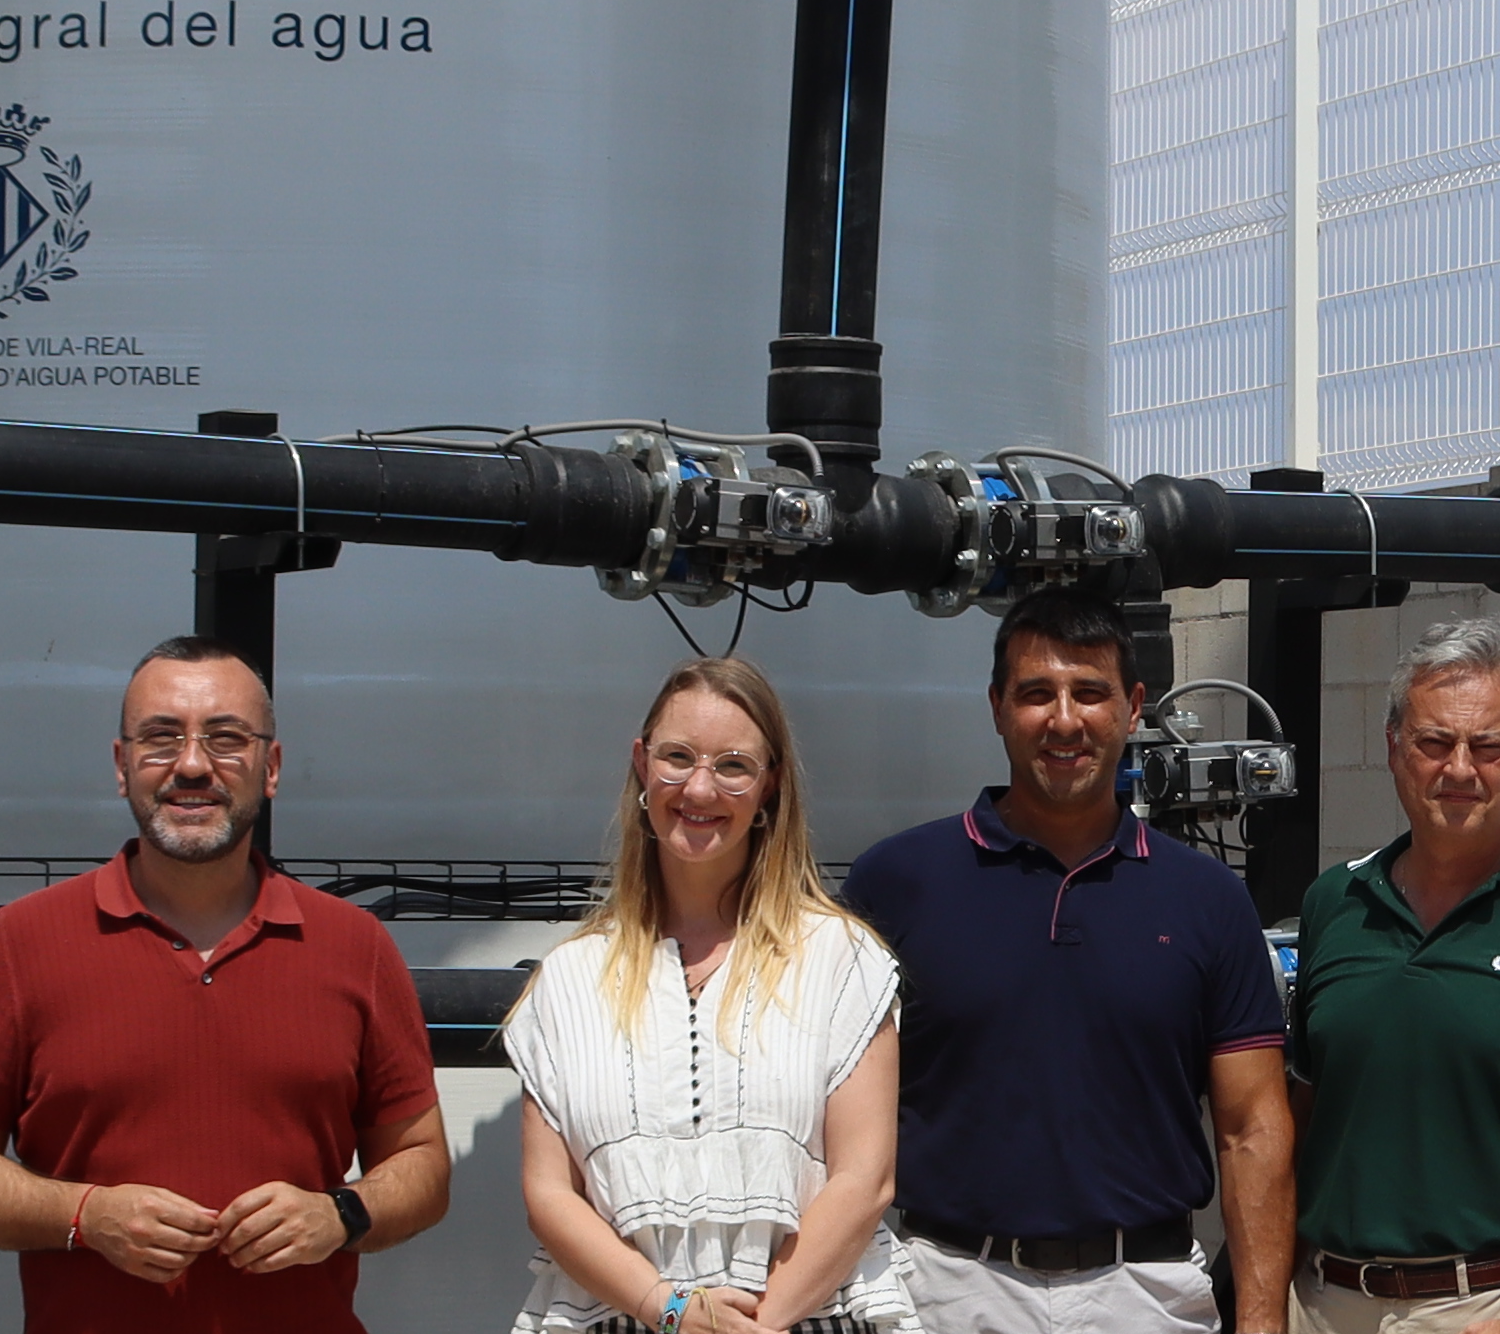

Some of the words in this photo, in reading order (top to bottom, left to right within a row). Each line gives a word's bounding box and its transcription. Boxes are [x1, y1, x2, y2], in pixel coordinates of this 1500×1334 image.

[141, 0, 236, 48] del
[271, 12, 433, 62] agua
[25, 336, 145, 357] VILA-REAL
[94, 366, 201, 386] POTABLE
